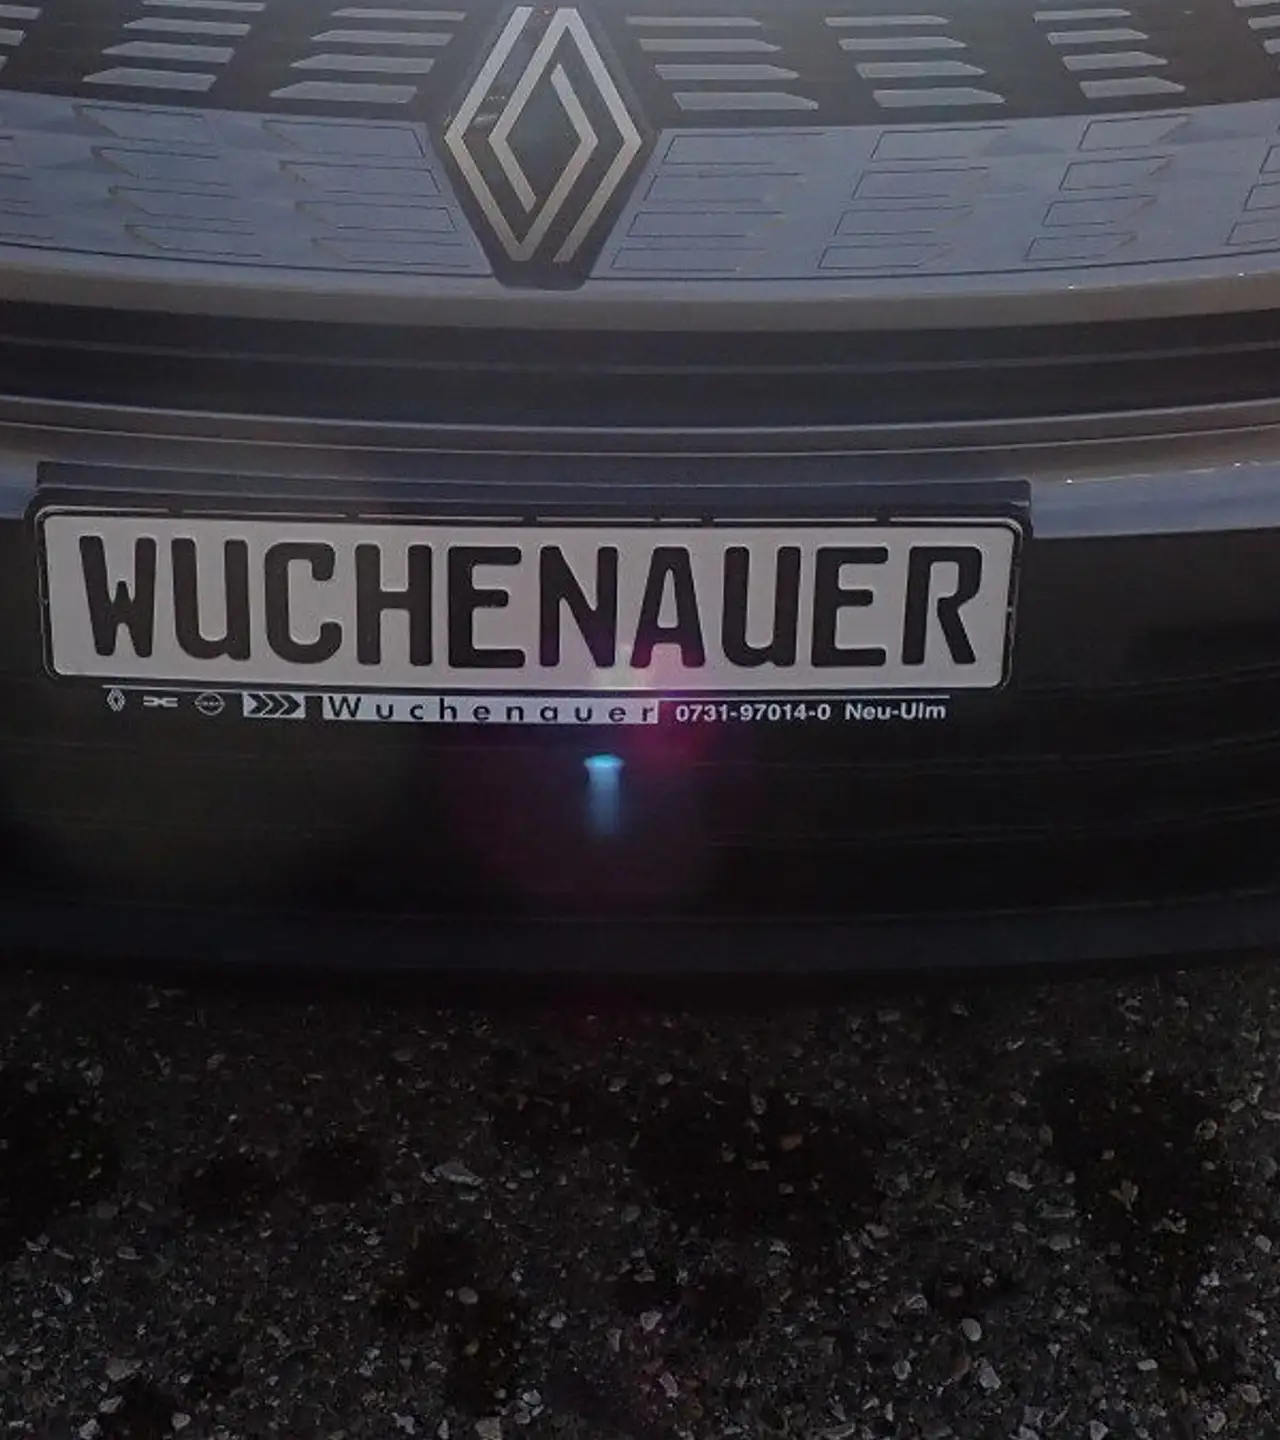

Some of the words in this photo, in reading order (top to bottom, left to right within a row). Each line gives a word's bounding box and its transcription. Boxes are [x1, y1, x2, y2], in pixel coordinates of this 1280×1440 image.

[78, 534, 984, 670] WUCHENAUER
[328, 695, 655, 722] Wuchenauer
[675, 702, 832, 722] 0731-97014-0
[844, 701, 947, 721] Neu-Ulm
